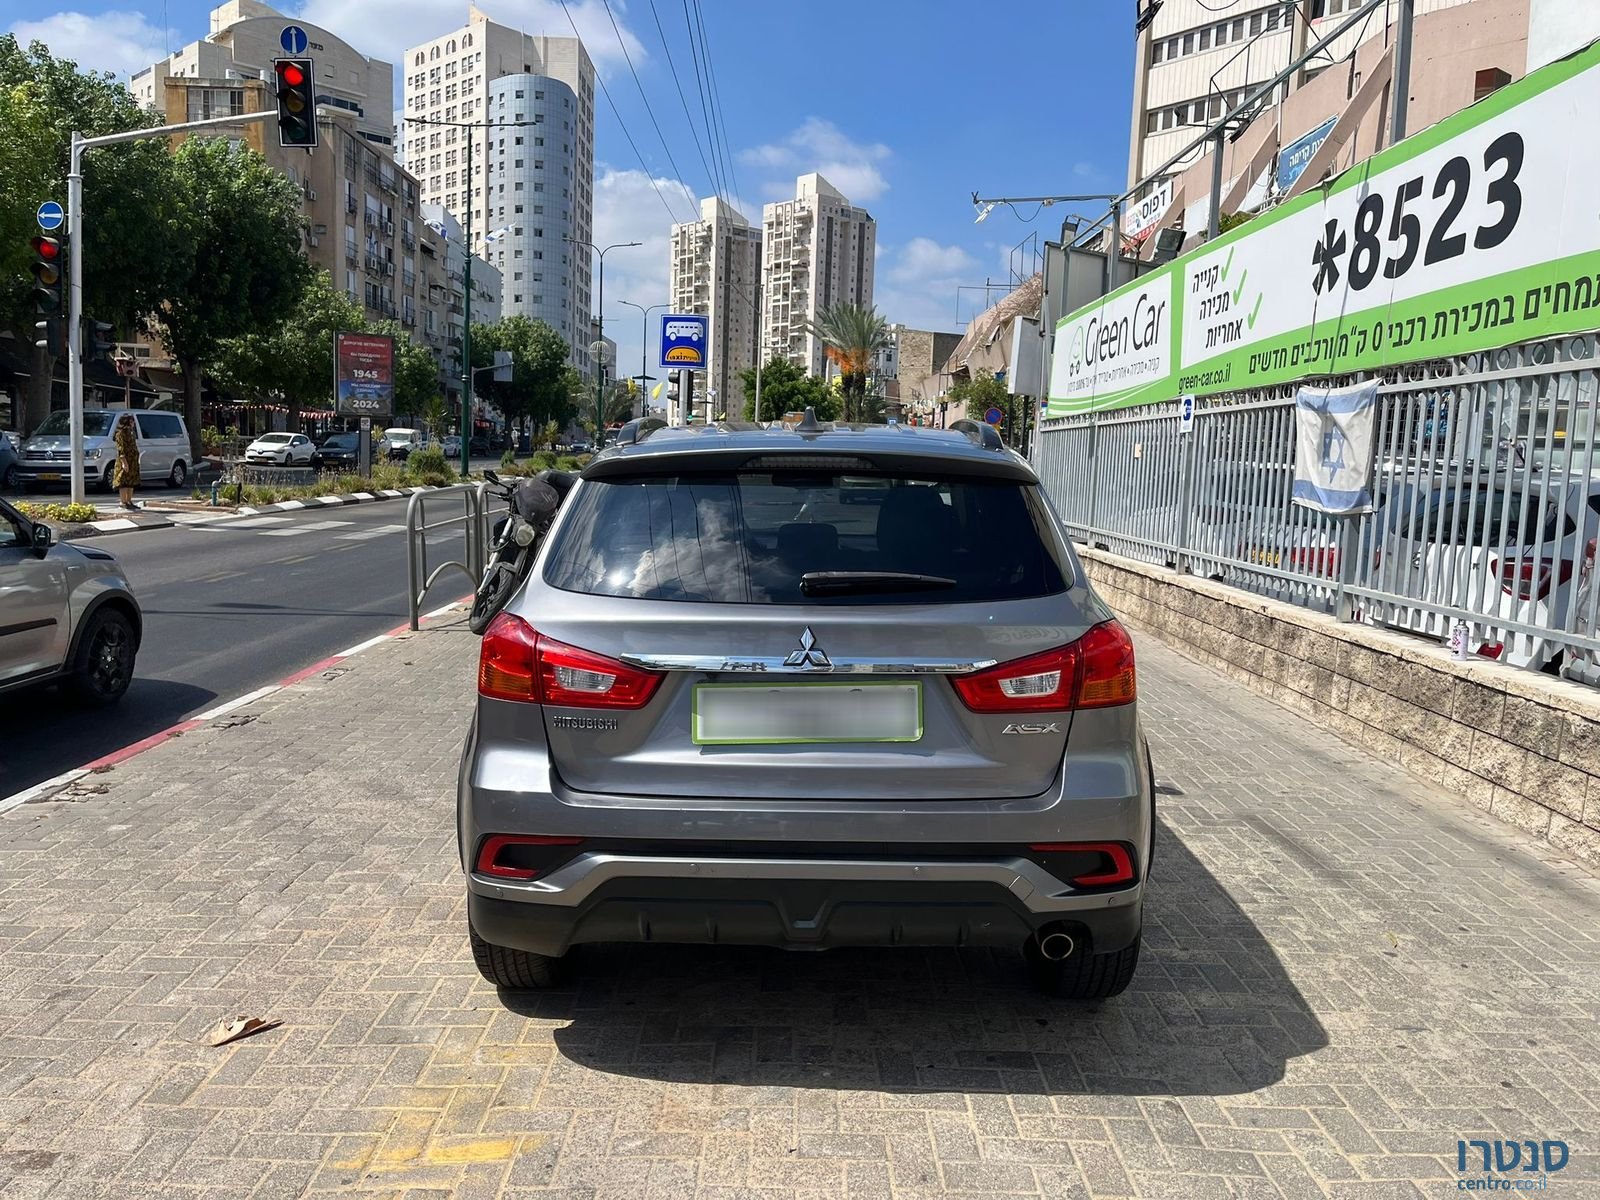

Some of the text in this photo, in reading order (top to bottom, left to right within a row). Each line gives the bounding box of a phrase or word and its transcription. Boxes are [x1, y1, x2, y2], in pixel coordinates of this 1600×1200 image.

[1143, 189, 1167, 219] דפוס
[1192, 264, 1219, 294] קנייה
[1199, 290, 1230, 321] מכירה
[1523, 273, 1600, 321] מחים
[1085, 293, 1166, 367] Green Car
[1388, 316, 1426, 348] רכבי
[1431, 294, 1515, 340] במכירת
[1205, 318, 1243, 349] אחריות
[1372, 320, 1383, 352] 0
[1248, 347, 1288, 374] חדשים
[1290, 336, 1334, 366] ורכבים
[353, 369, 378, 379] 1945
[1178, 362, 1232, 394] green-car.co.il
[352, 399, 379, 409] 2024
[553, 715, 618, 730] MITSUBISHI
[1001, 722, 1060, 735] ASX
